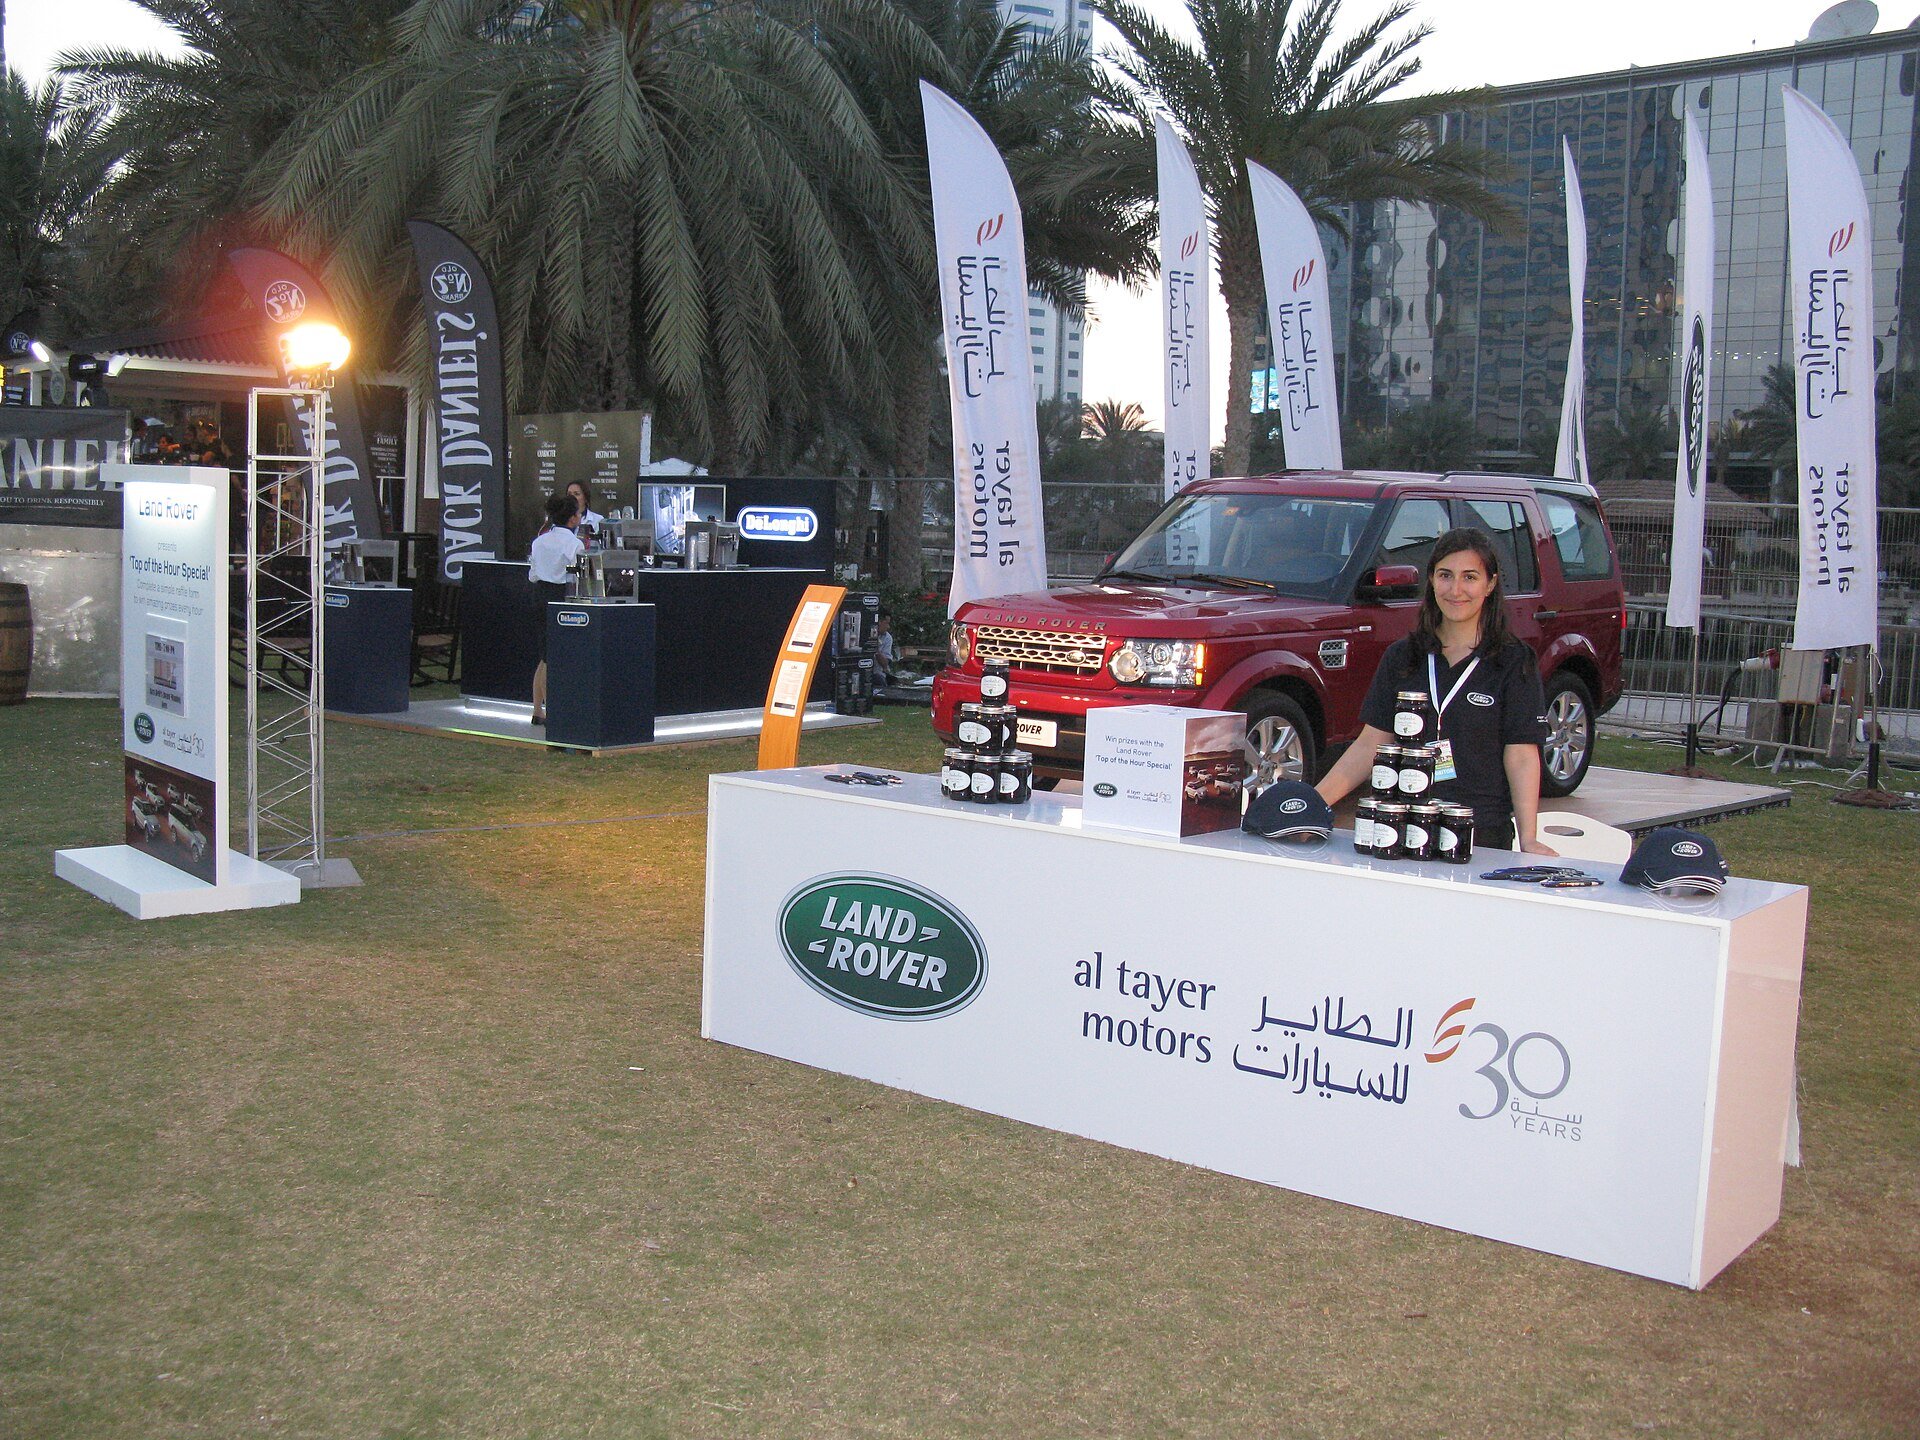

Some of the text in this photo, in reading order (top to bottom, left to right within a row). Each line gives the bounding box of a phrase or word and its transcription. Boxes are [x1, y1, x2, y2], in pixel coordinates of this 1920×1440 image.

[54, 498, 105, 506] RESPONSIBLY
[139, 496, 198, 521] Land Rover
[144, 557, 151, 571] of
[152, 558, 162, 573] the
[163, 560, 181, 576] Hour
[984, 613, 1106, 631] LAND ROVER
[1105, 735, 1164, 748] Win prizes with the
[1116, 747, 1152, 757] Land Rover
[1118, 757, 1128, 765] the
[1129, 759, 1145, 767] Hour
[820, 896, 917, 944] LAND
[826, 937, 948, 993] ROVER
[1074, 951, 1216, 1013] al tayer
[1082, 1011, 1212, 1063] motors
[1251, 996, 1413, 1050] الطاير
[1232, 1043, 1409, 1105] للسيارات
[1458, 1022, 1571, 1120] 30
[1510, 1114, 1582, 1142] YEARS
